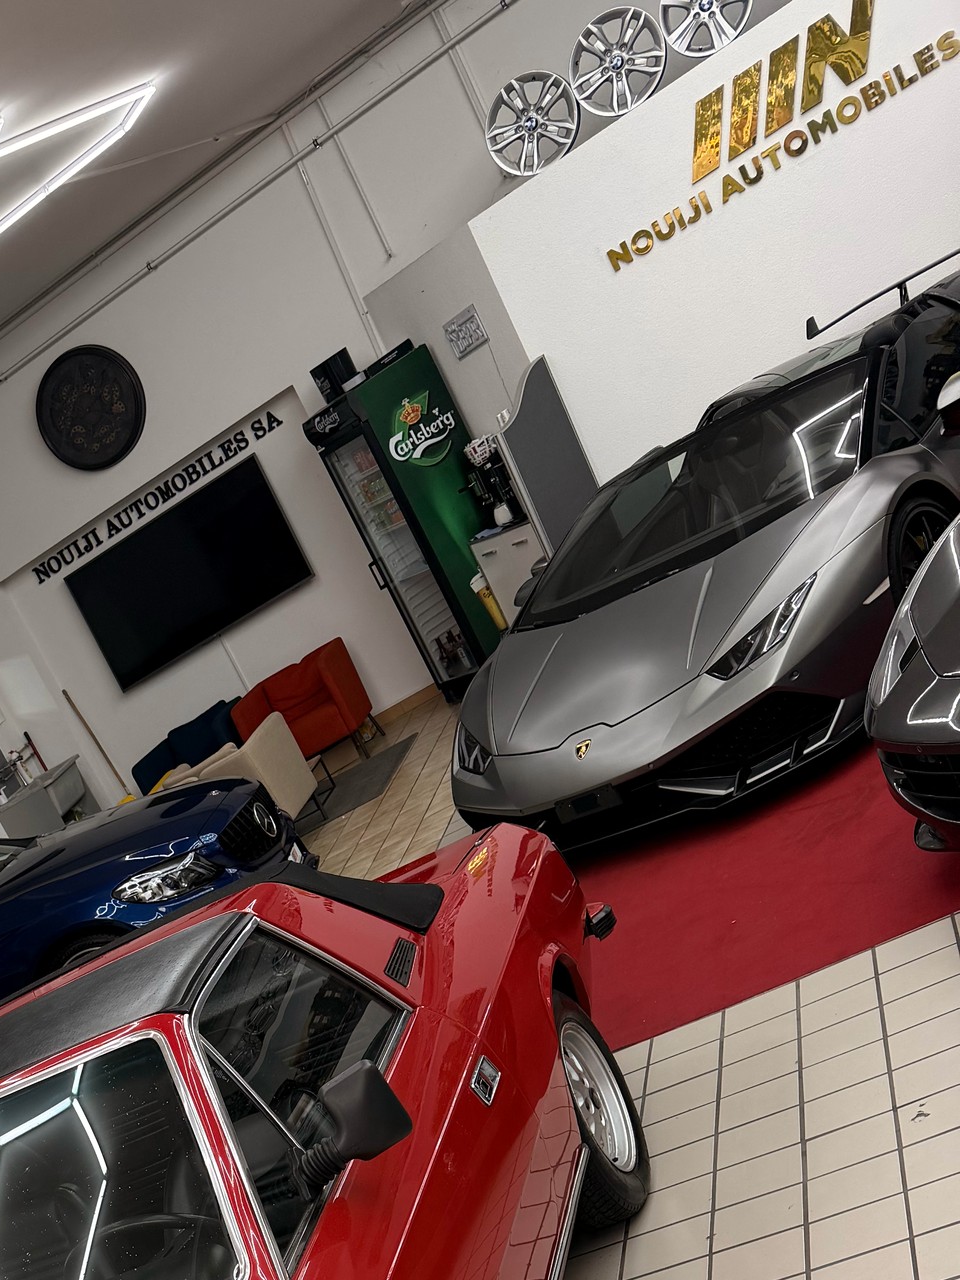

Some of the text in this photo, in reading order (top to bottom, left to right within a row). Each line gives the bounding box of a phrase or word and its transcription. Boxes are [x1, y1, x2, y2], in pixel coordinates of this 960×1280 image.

[606, 30, 960, 273] NOUIJI AUTOMOBILES
[314, 409, 340, 433] Carlsberg
[388, 408, 456, 462] Carlsberg
[31, 410, 283, 584] NOUIJI AUTOMOBILES SA
